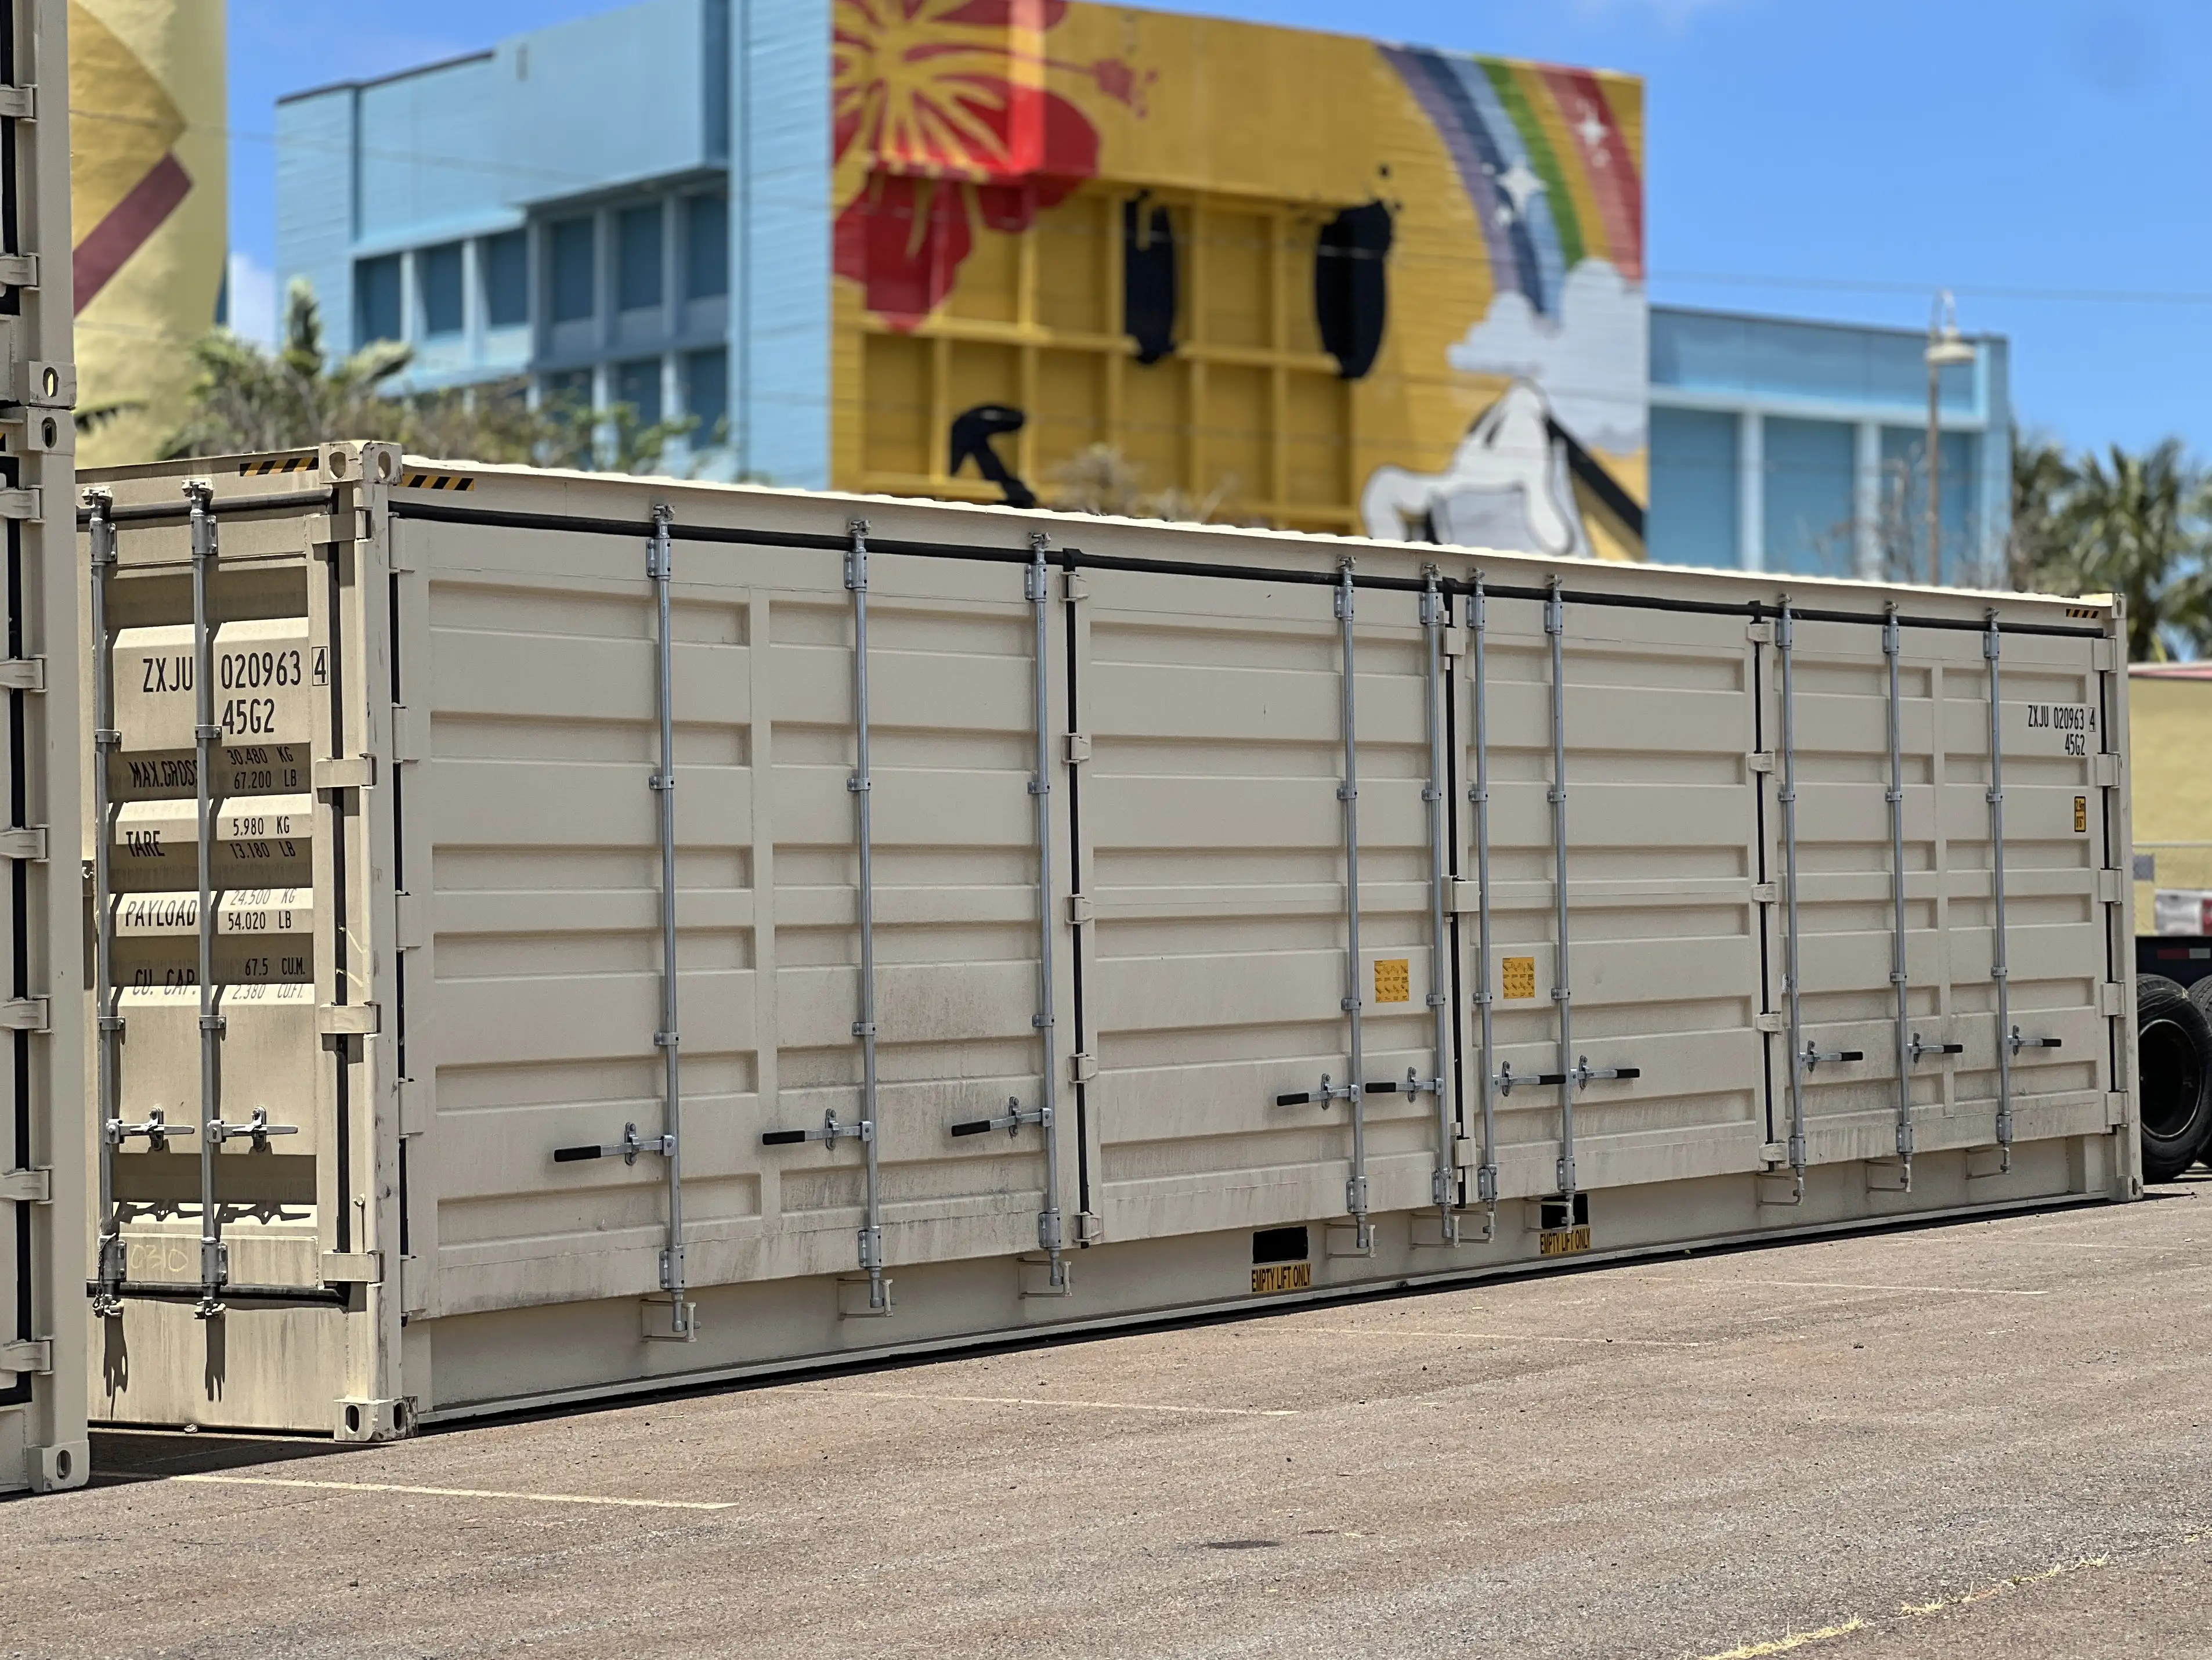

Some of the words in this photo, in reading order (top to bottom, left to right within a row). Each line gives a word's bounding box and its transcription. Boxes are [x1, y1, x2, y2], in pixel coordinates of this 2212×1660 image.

[143, 656, 193, 692] ZXJU
[221, 650, 301, 690] 020963
[314, 648, 327, 684] 4
[222, 698, 275, 735] 45G2
[2028, 705, 2049, 727] ZXJU
[2054, 707, 2084, 730] 020963
[2090, 709, 2095, 731] 4
[227, 748, 268, 766] 30.480
[276, 746, 294, 763] KG
[2065, 734, 2086, 756] 45G2
[234, 770, 271, 789] 67.200
[284, 769, 297, 787] LB
[233, 817, 264, 836] 5.980
[277, 815, 290, 834] KG
[126, 831, 165, 857] TARE
[230, 842, 270, 859] 13.180
[279, 840, 296, 857] LB
[230, 889, 271, 905] 24.500
[281, 887, 297, 904] KG
[125, 900, 197, 927] PAYLOAD
[228, 911, 266, 930] 54.020
[279, 911, 291, 929] LB
[245, 957, 268, 976] 67.5
[281, 957, 305, 975] CU.M.
[132, 969, 153, 995] CU.
[164, 968, 196, 995] CAP.
[232, 983, 266, 999] 2.380
[1541, 1232, 1560, 1254] EMPTY
[1562, 1230, 1574, 1251] LIFT
[1575, 1228, 1591, 1250] ONLY
[1252, 1267, 1275, 1293] EMPTY
[1277, 1266, 1292, 1289] LIFT
[1293, 1263, 1311, 1287] ONLY
